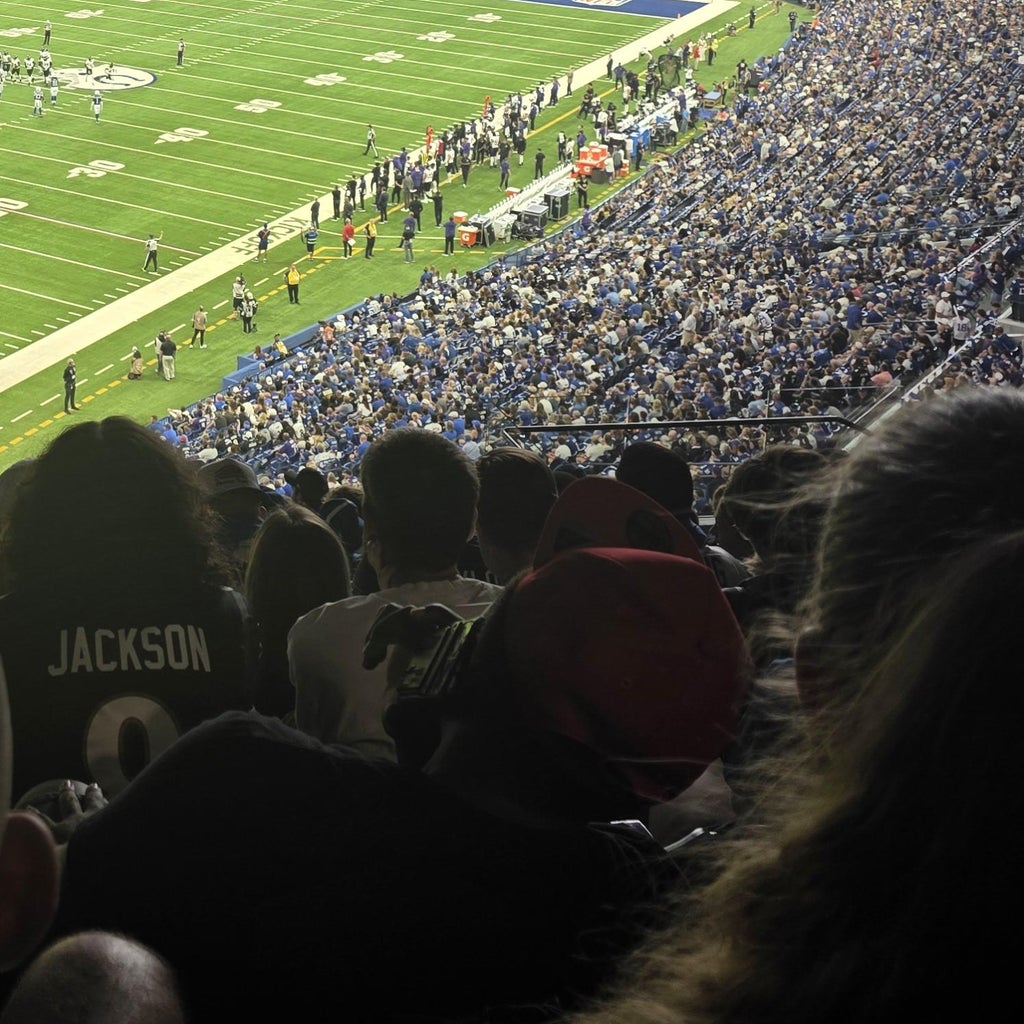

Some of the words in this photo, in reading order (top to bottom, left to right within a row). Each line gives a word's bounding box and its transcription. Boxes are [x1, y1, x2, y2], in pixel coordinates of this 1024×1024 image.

[154, 127, 209, 144] 40
[66, 159, 125, 178] 30
[48, 624, 210, 676] JACKSON
